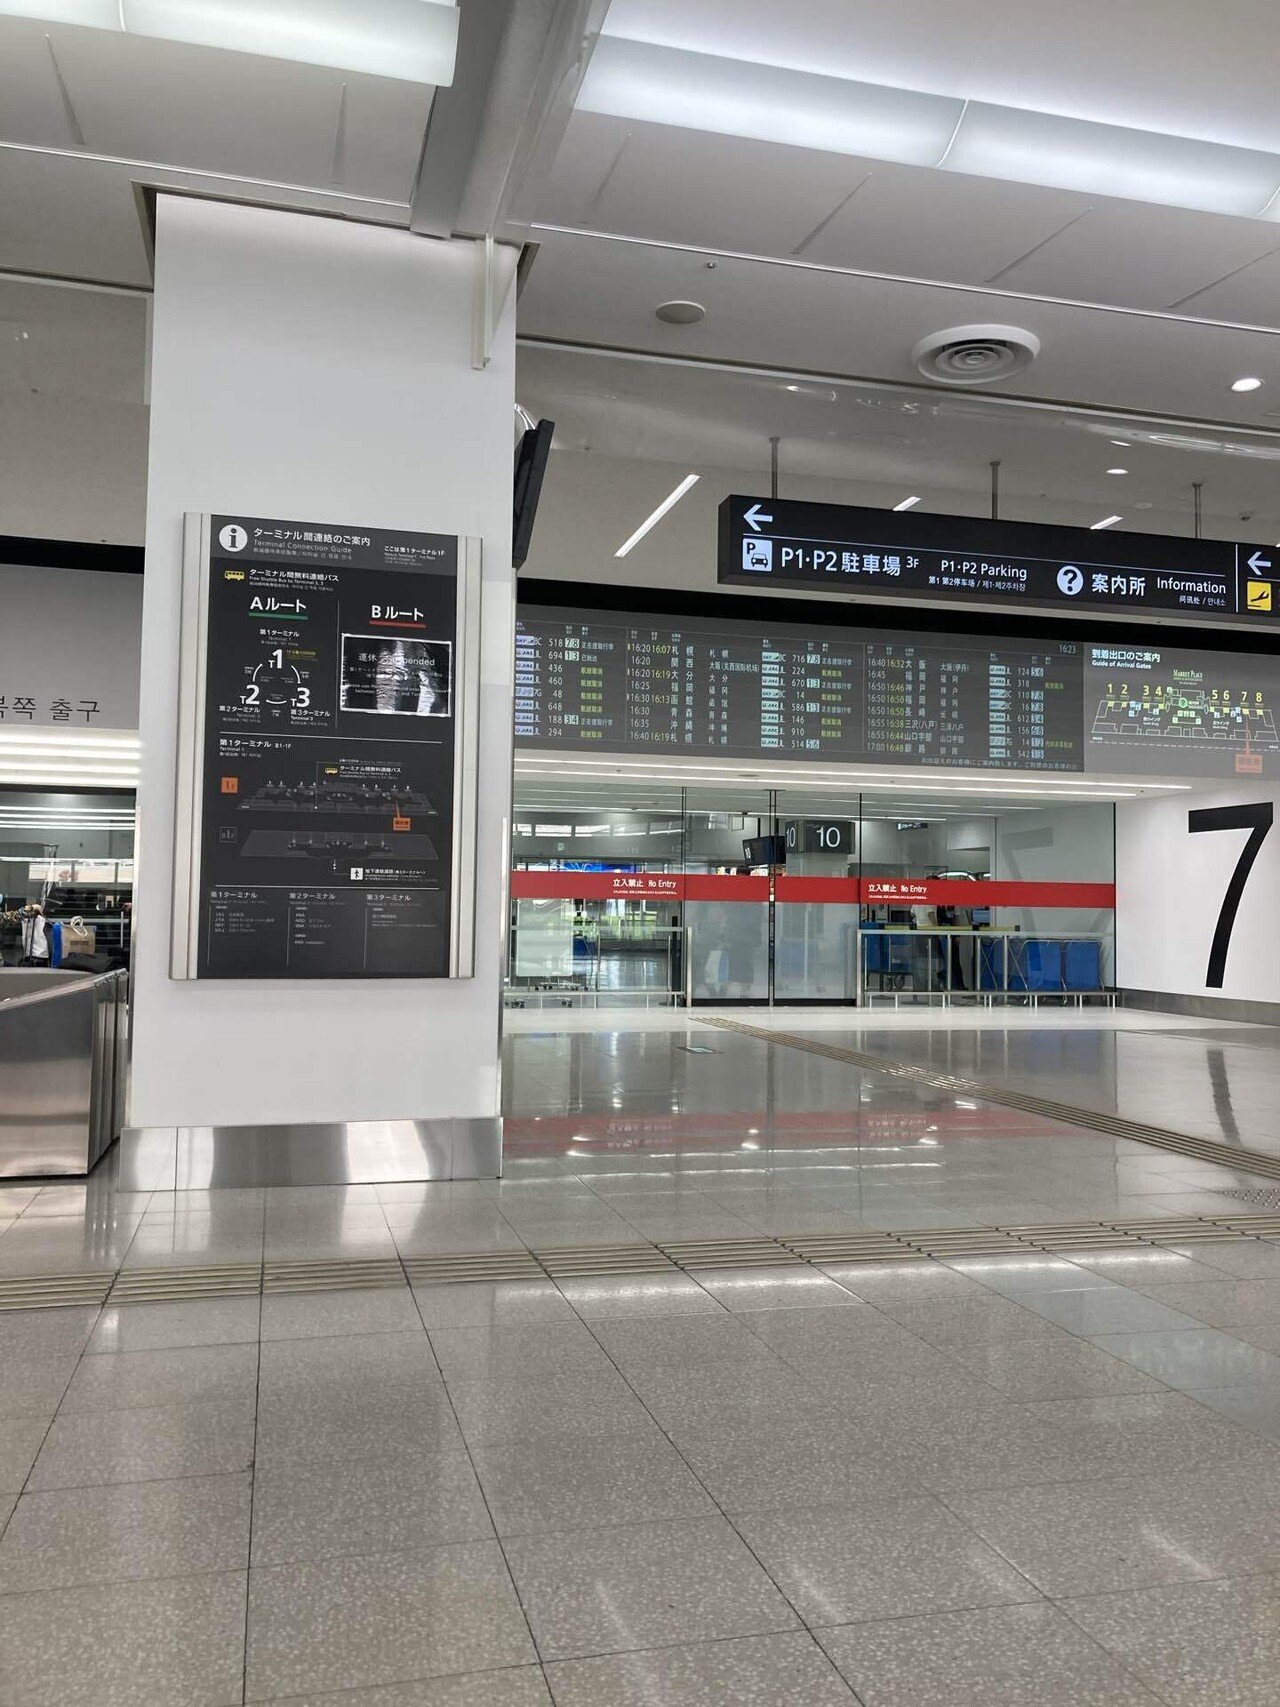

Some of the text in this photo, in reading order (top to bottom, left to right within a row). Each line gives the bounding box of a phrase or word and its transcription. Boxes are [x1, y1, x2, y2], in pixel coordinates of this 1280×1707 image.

[330, 546, 352, 554] Guide
[905, 556, 919, 568] 3F
[980, 563, 1028, 581] Parking
[1091, 573, 1146, 597] 案内所
[1157, 576, 1227, 594] Information
[549, 638, 563, 648] 518
[549, 650, 563, 660] 694
[1092, 648, 1161, 662] 到着出口のご案内
[1107, 683, 1262, 702] 1 2 3 4 5 6 7 8
[50, 698, 100, 722] 출구
[786, 826, 841, 848] 10 10
[648, 879, 657, 888] No
[658, 879, 677, 889] Entry
[900, 884, 909, 893] No
[909, 884, 928, 894] Entry
[1188, 801, 1274, 989] 7
